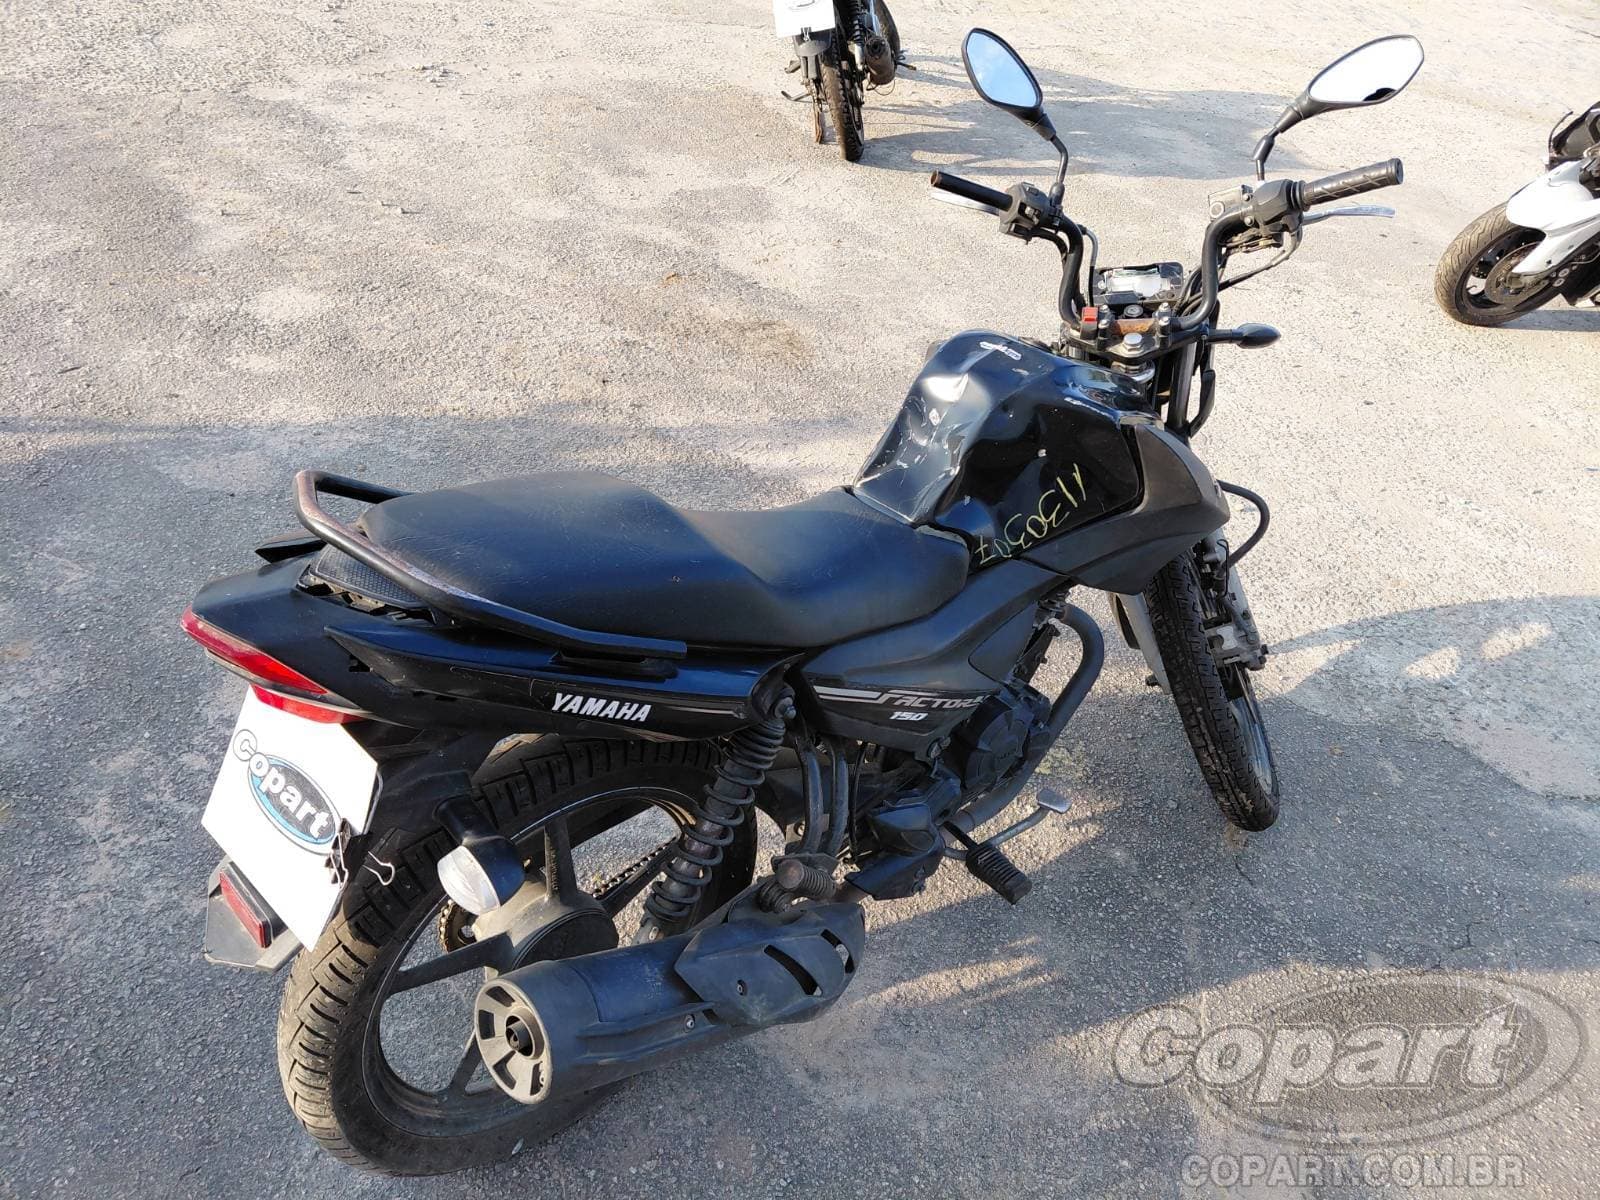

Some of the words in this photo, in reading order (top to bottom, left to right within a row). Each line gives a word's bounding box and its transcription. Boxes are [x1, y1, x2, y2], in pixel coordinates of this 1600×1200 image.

[552, 692, 652, 722] YAMAHA
[880, 692, 980, 709] FACTOR
[889, 711, 929, 721] 150
[233, 729, 330, 840] Copart
